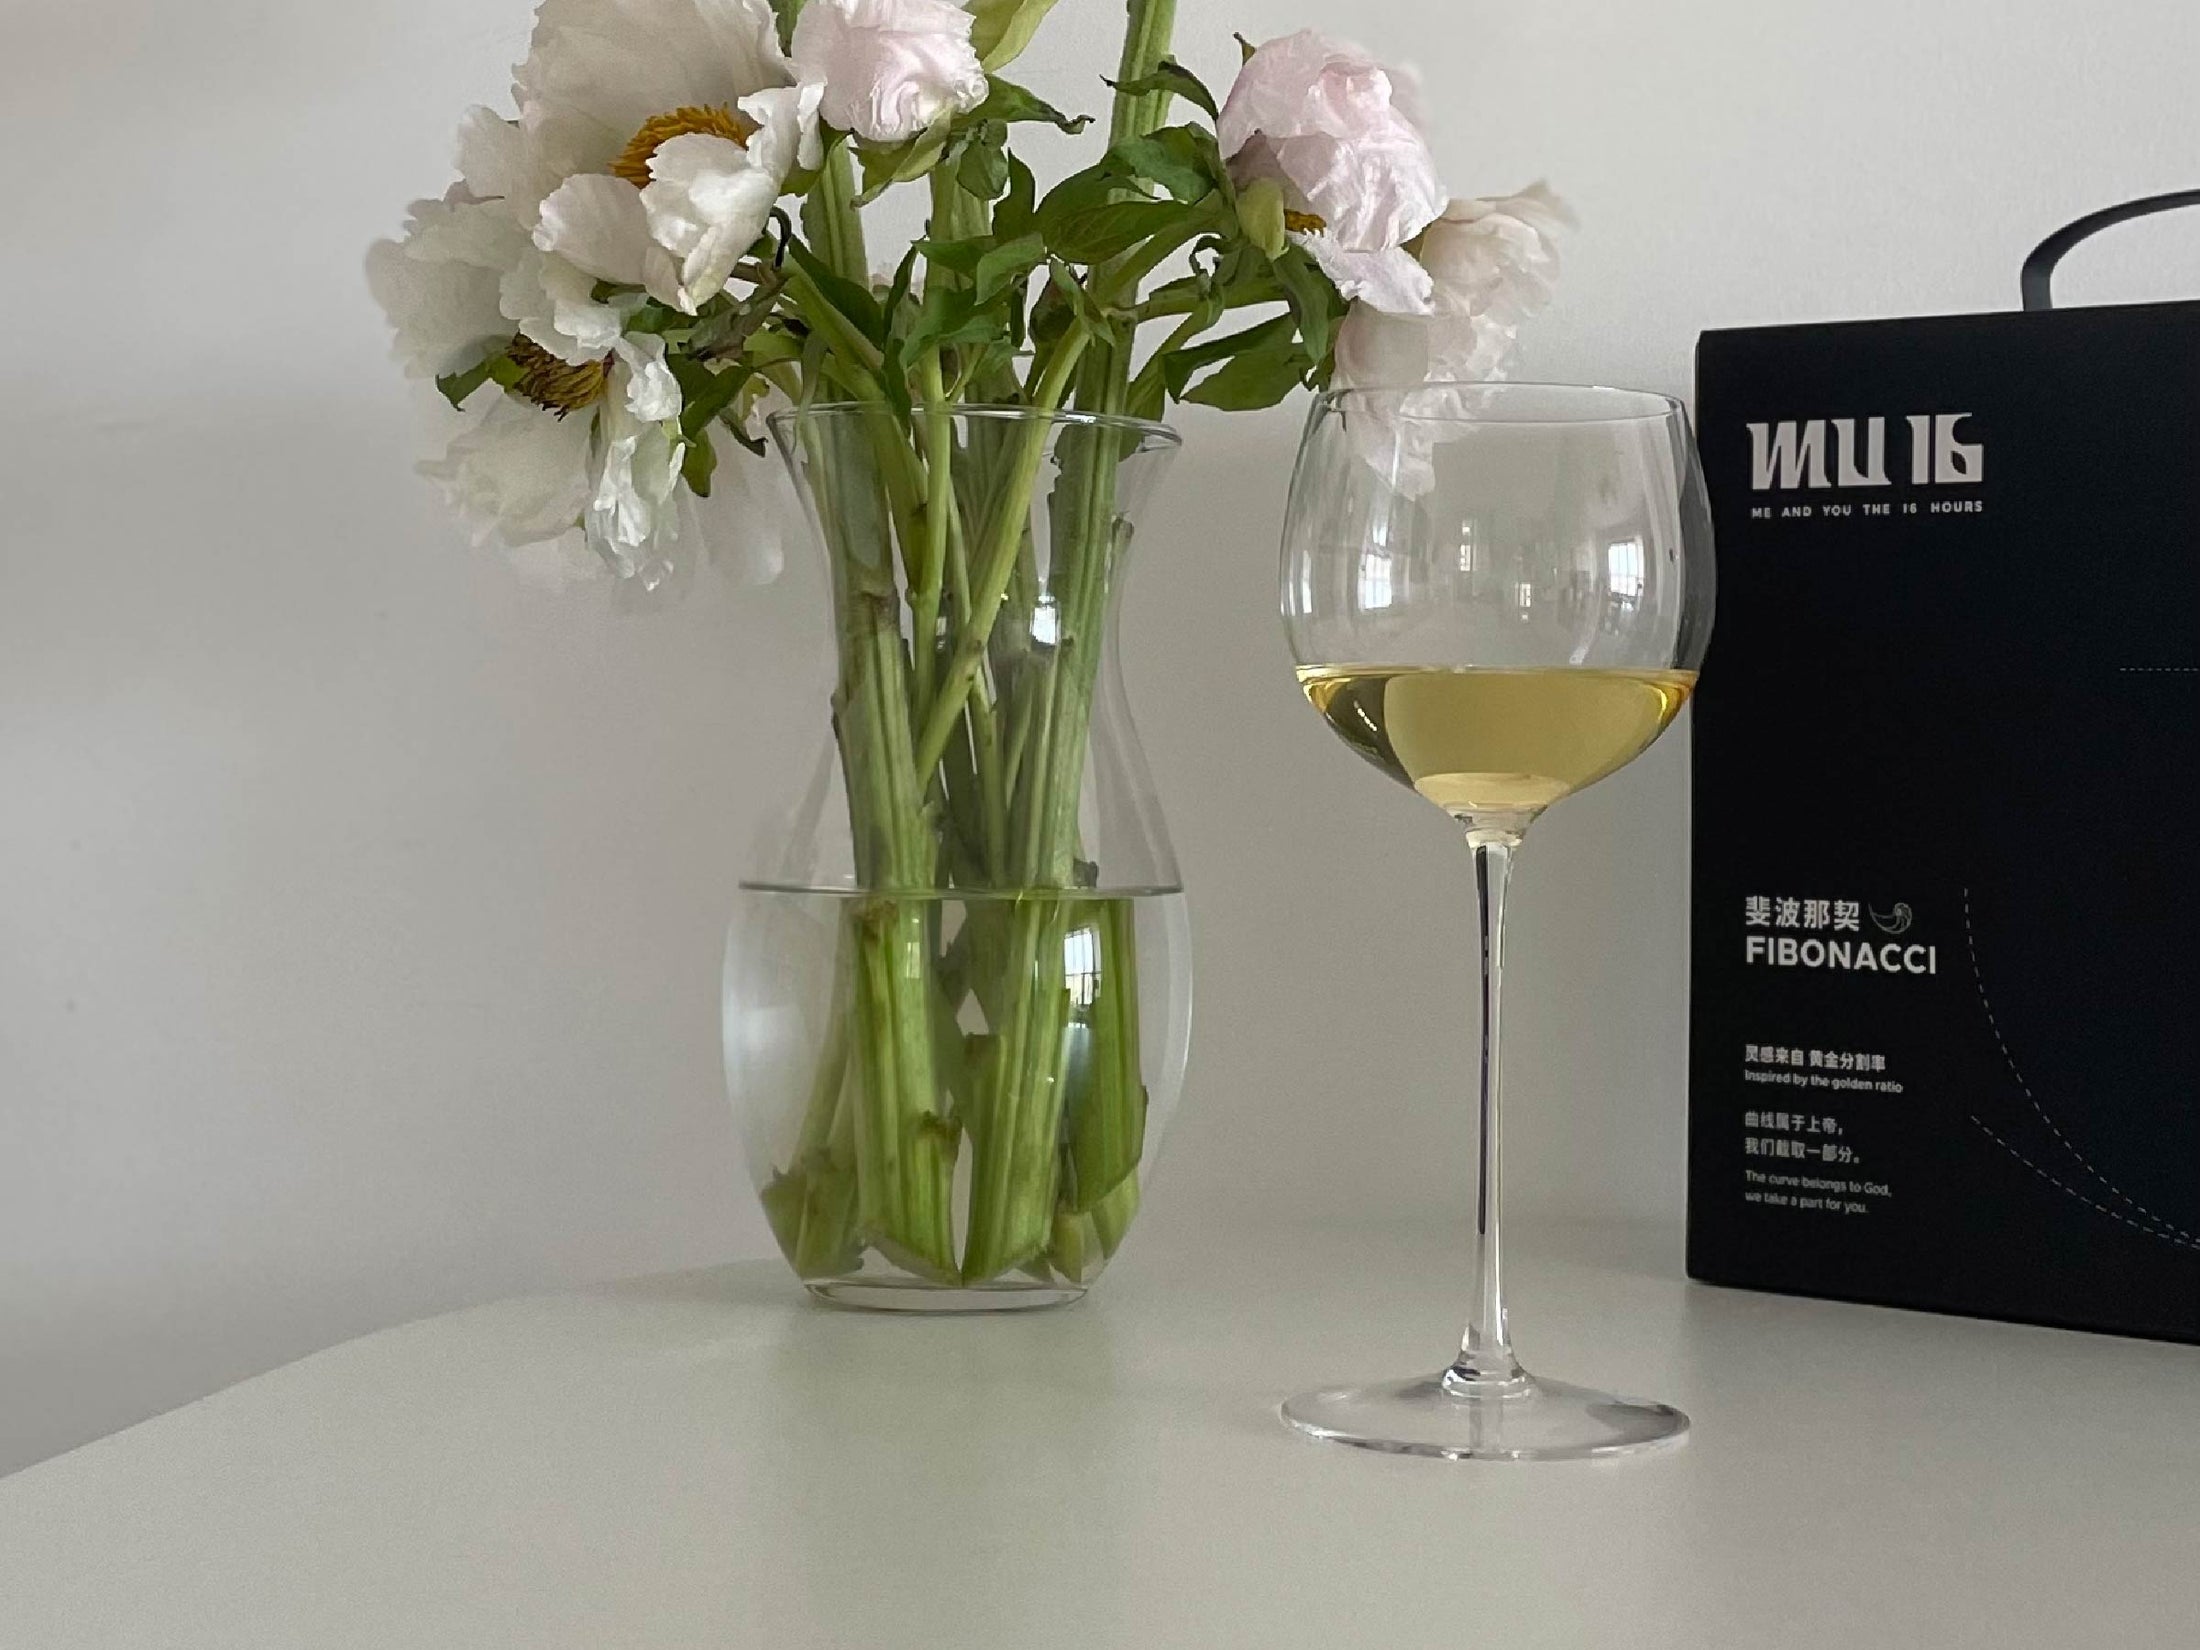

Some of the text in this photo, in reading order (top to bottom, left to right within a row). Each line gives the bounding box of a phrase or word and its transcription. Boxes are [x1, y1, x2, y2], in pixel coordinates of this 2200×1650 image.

[1746, 412, 1984, 490] MU 16
[1752, 500, 1983, 519] ME AND YOU THE 16 HOURS
[1745, 895, 1860, 932] 斐波那契
[1746, 935, 1936, 975] FIBONACCI
[1745, 1043, 1804, 1067] 灵感来自
[1744, 1069, 1904, 1094] Inspired by the golden ratio
[1745, 1169, 1893, 1198] The curve belongs to God,
[1745, 1192, 1762, 1202] we
[1764, 1192, 1788, 1205] take
[1790, 1196, 1798, 1206] a
[1799, 1196, 1823, 1209] part
[1825, 1197, 1842, 1210] for
